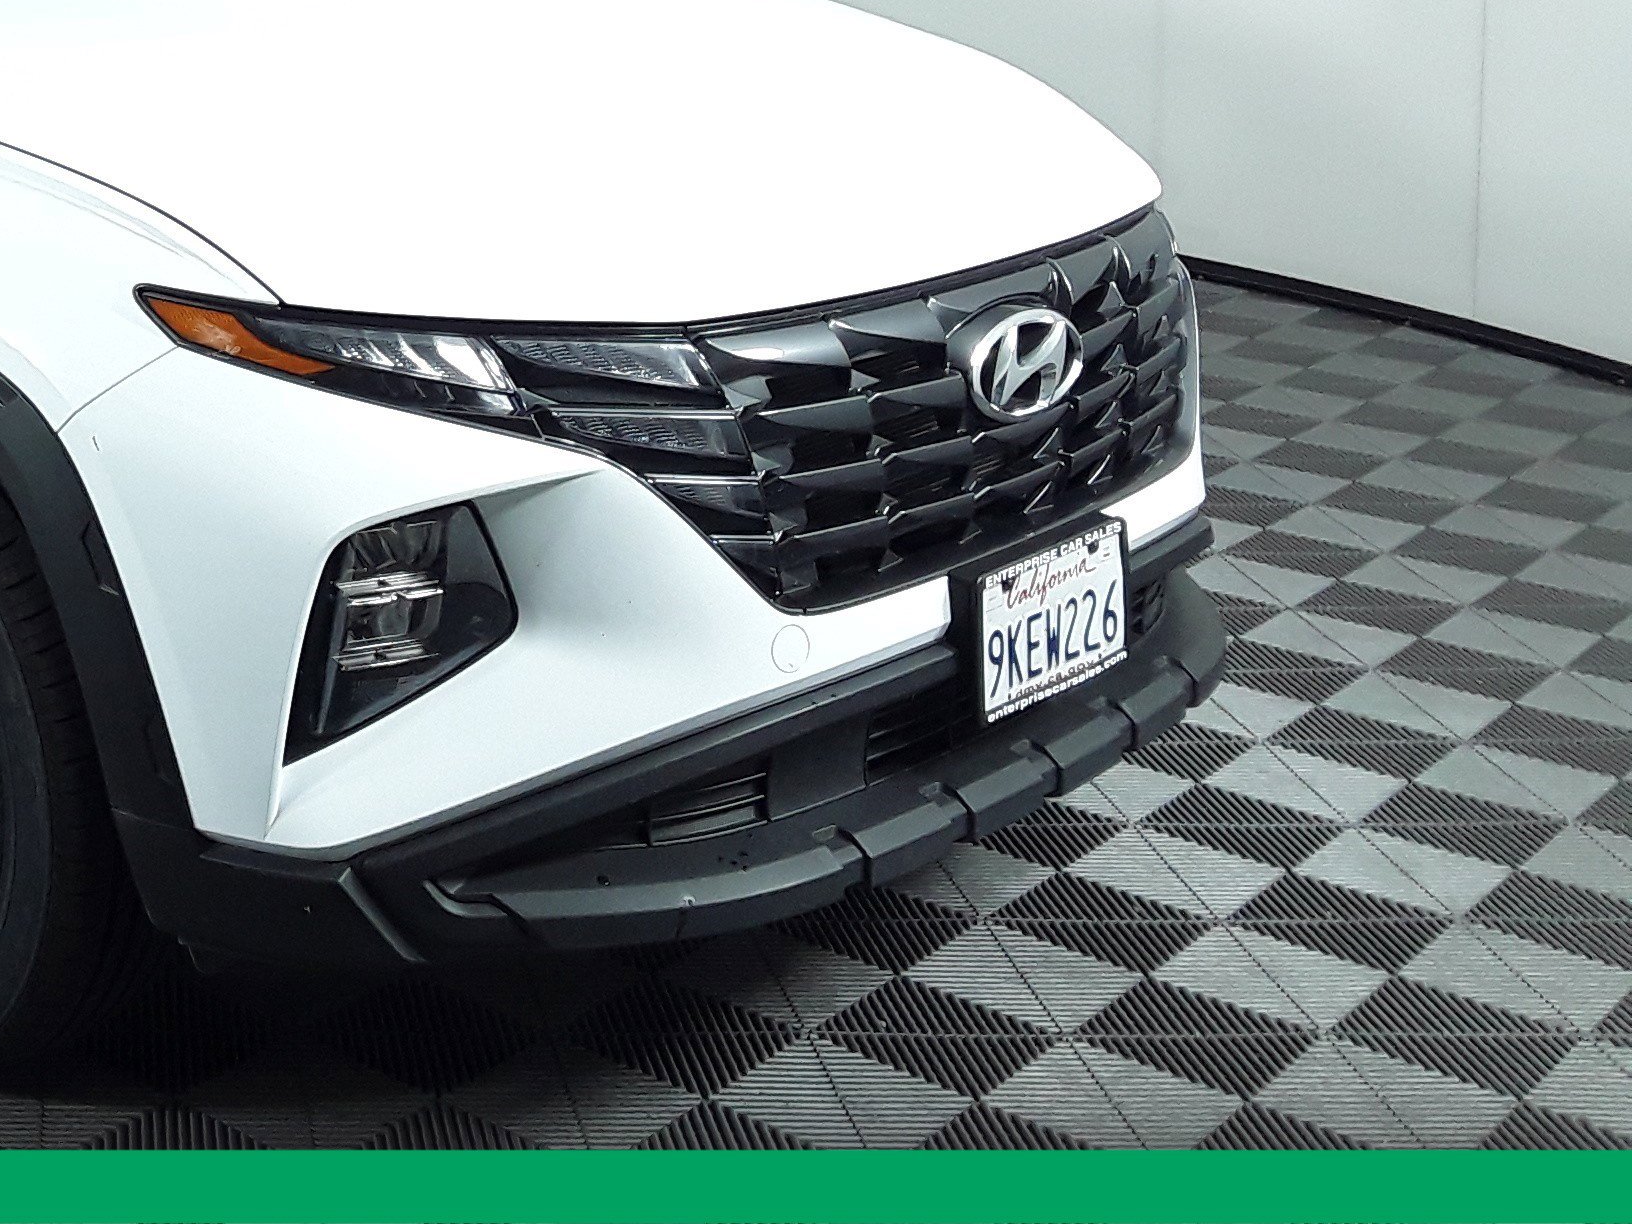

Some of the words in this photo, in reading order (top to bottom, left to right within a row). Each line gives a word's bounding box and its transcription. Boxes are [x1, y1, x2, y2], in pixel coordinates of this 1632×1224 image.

[985, 548, 1058, 589] ENTERPRISE
[1060, 537, 1083, 557] CAR
[1084, 521, 1122, 545] SALES
[1006, 557, 1097, 609] California
[987, 579, 1118, 699] 9KEW226
[987, 650, 1128, 723] enterprisecarsales.com
